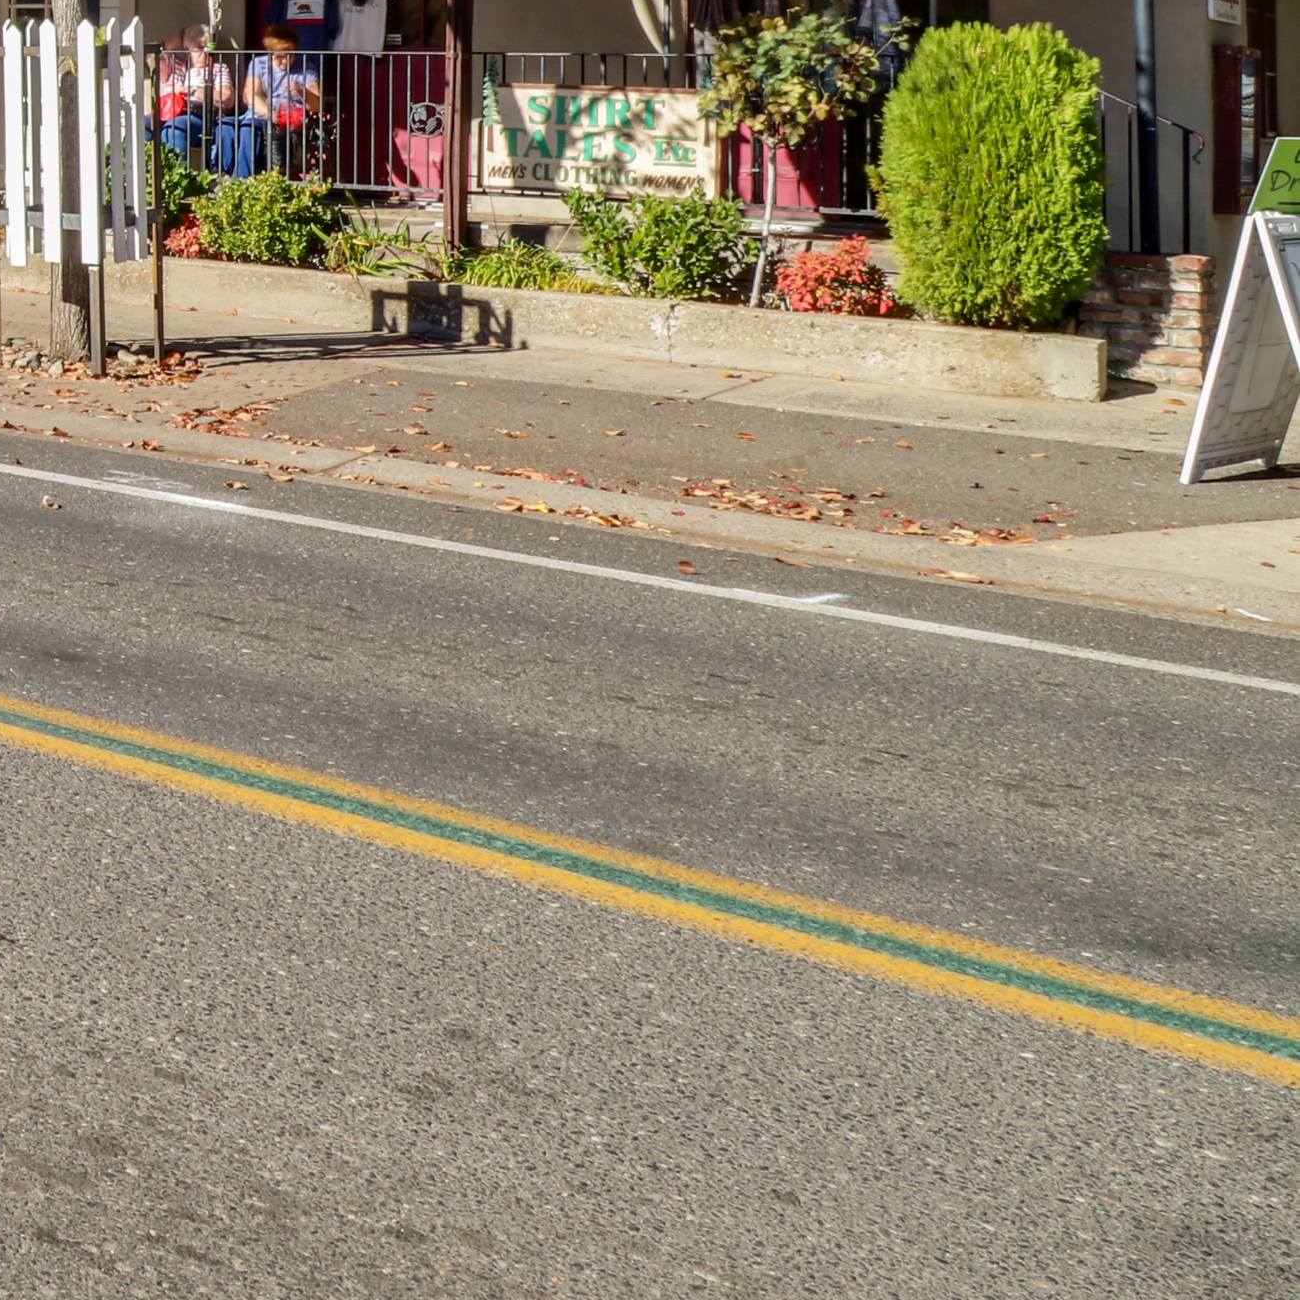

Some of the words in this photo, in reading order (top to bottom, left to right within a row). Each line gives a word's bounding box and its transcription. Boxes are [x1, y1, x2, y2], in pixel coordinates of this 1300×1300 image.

[528, 95, 666, 130] SHIRT
[500, 127, 637, 164] TALES
[654, 139, 698, 163] Etc
[488, 163, 527, 179] MEN'S
[532, 162, 638, 187] CLOTHING
[642, 173, 705, 190] WOMEN'S
